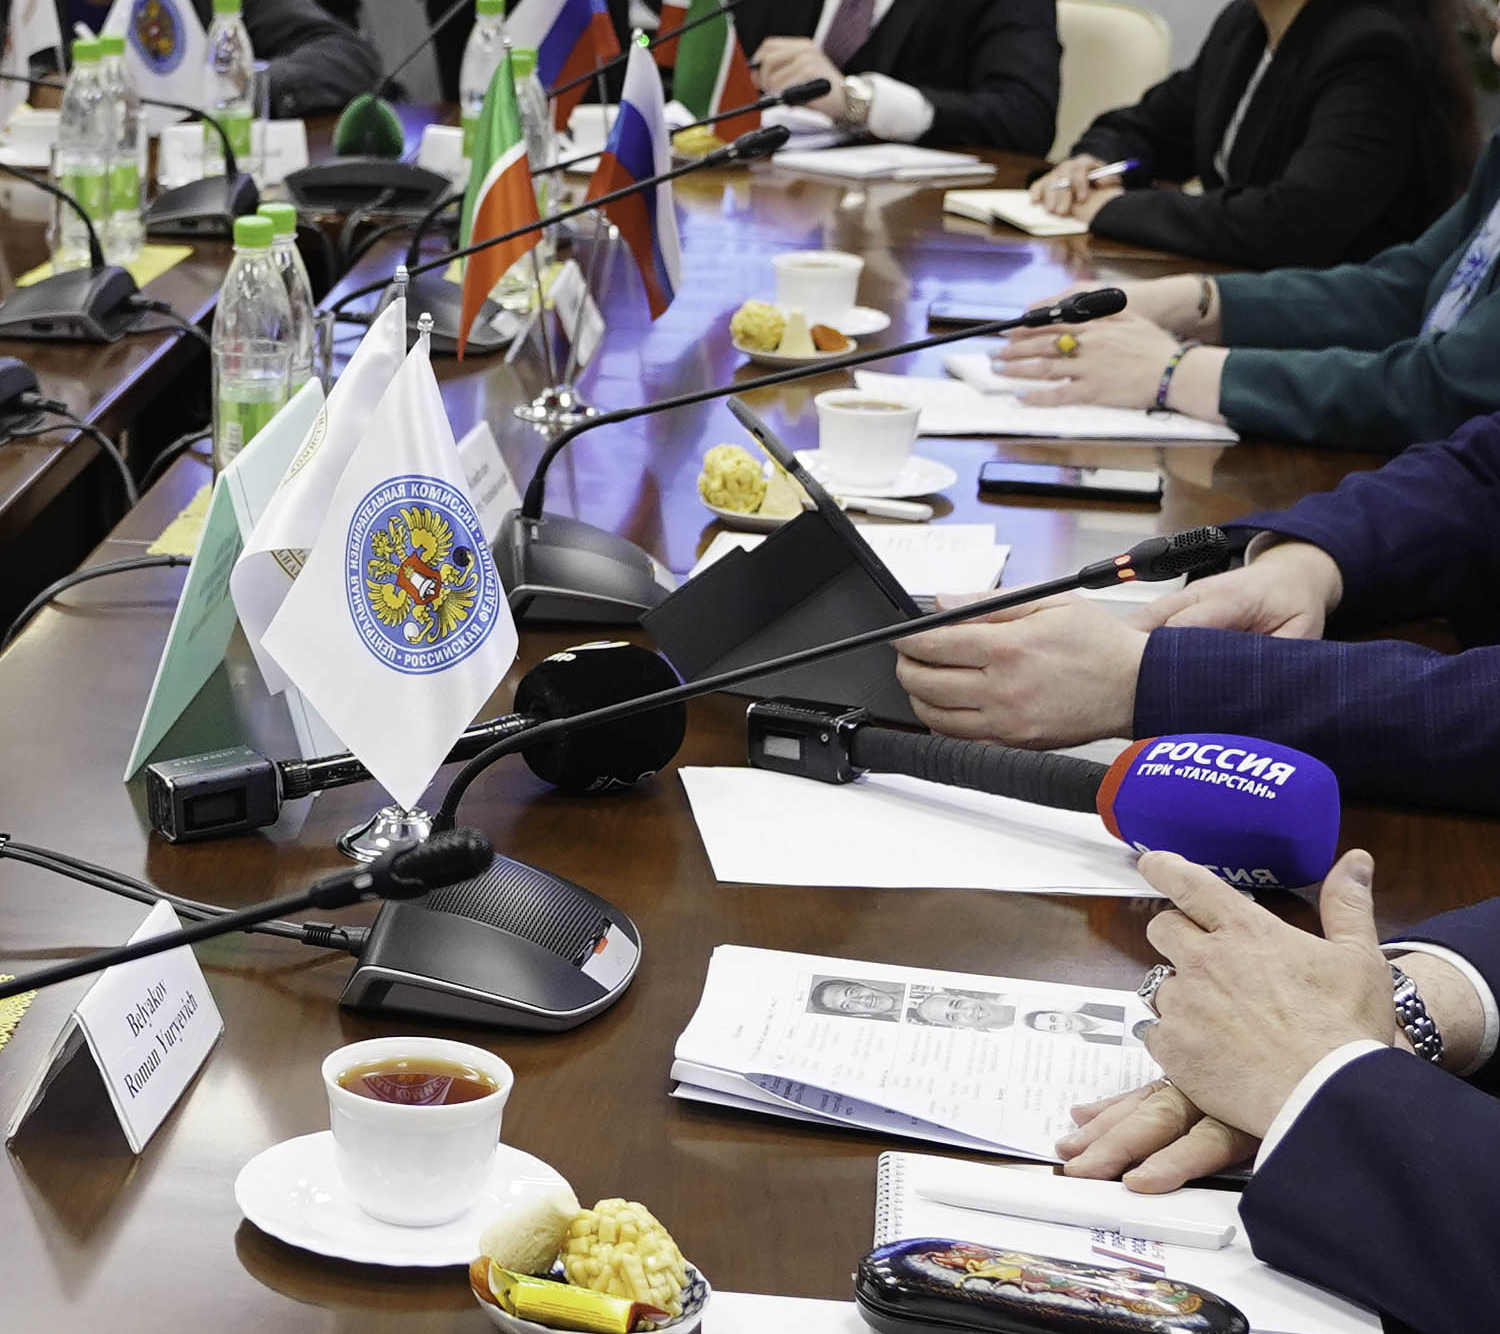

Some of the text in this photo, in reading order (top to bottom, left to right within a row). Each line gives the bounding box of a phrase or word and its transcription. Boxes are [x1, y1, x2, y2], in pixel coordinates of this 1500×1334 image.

[349, 482, 407, 571] ИЗБИРАТЕЛЬНАЯ
[410, 481, 480, 533] КОМИССИЯ
[1137, 763, 1276, 799] ГТРК «ТАТАРСТАН»
[1146, 741, 1297, 786] РОССИЯ
[126, 978, 169, 1038] Belyakov
[123, 990, 199, 1099] Roman Yuryevich
